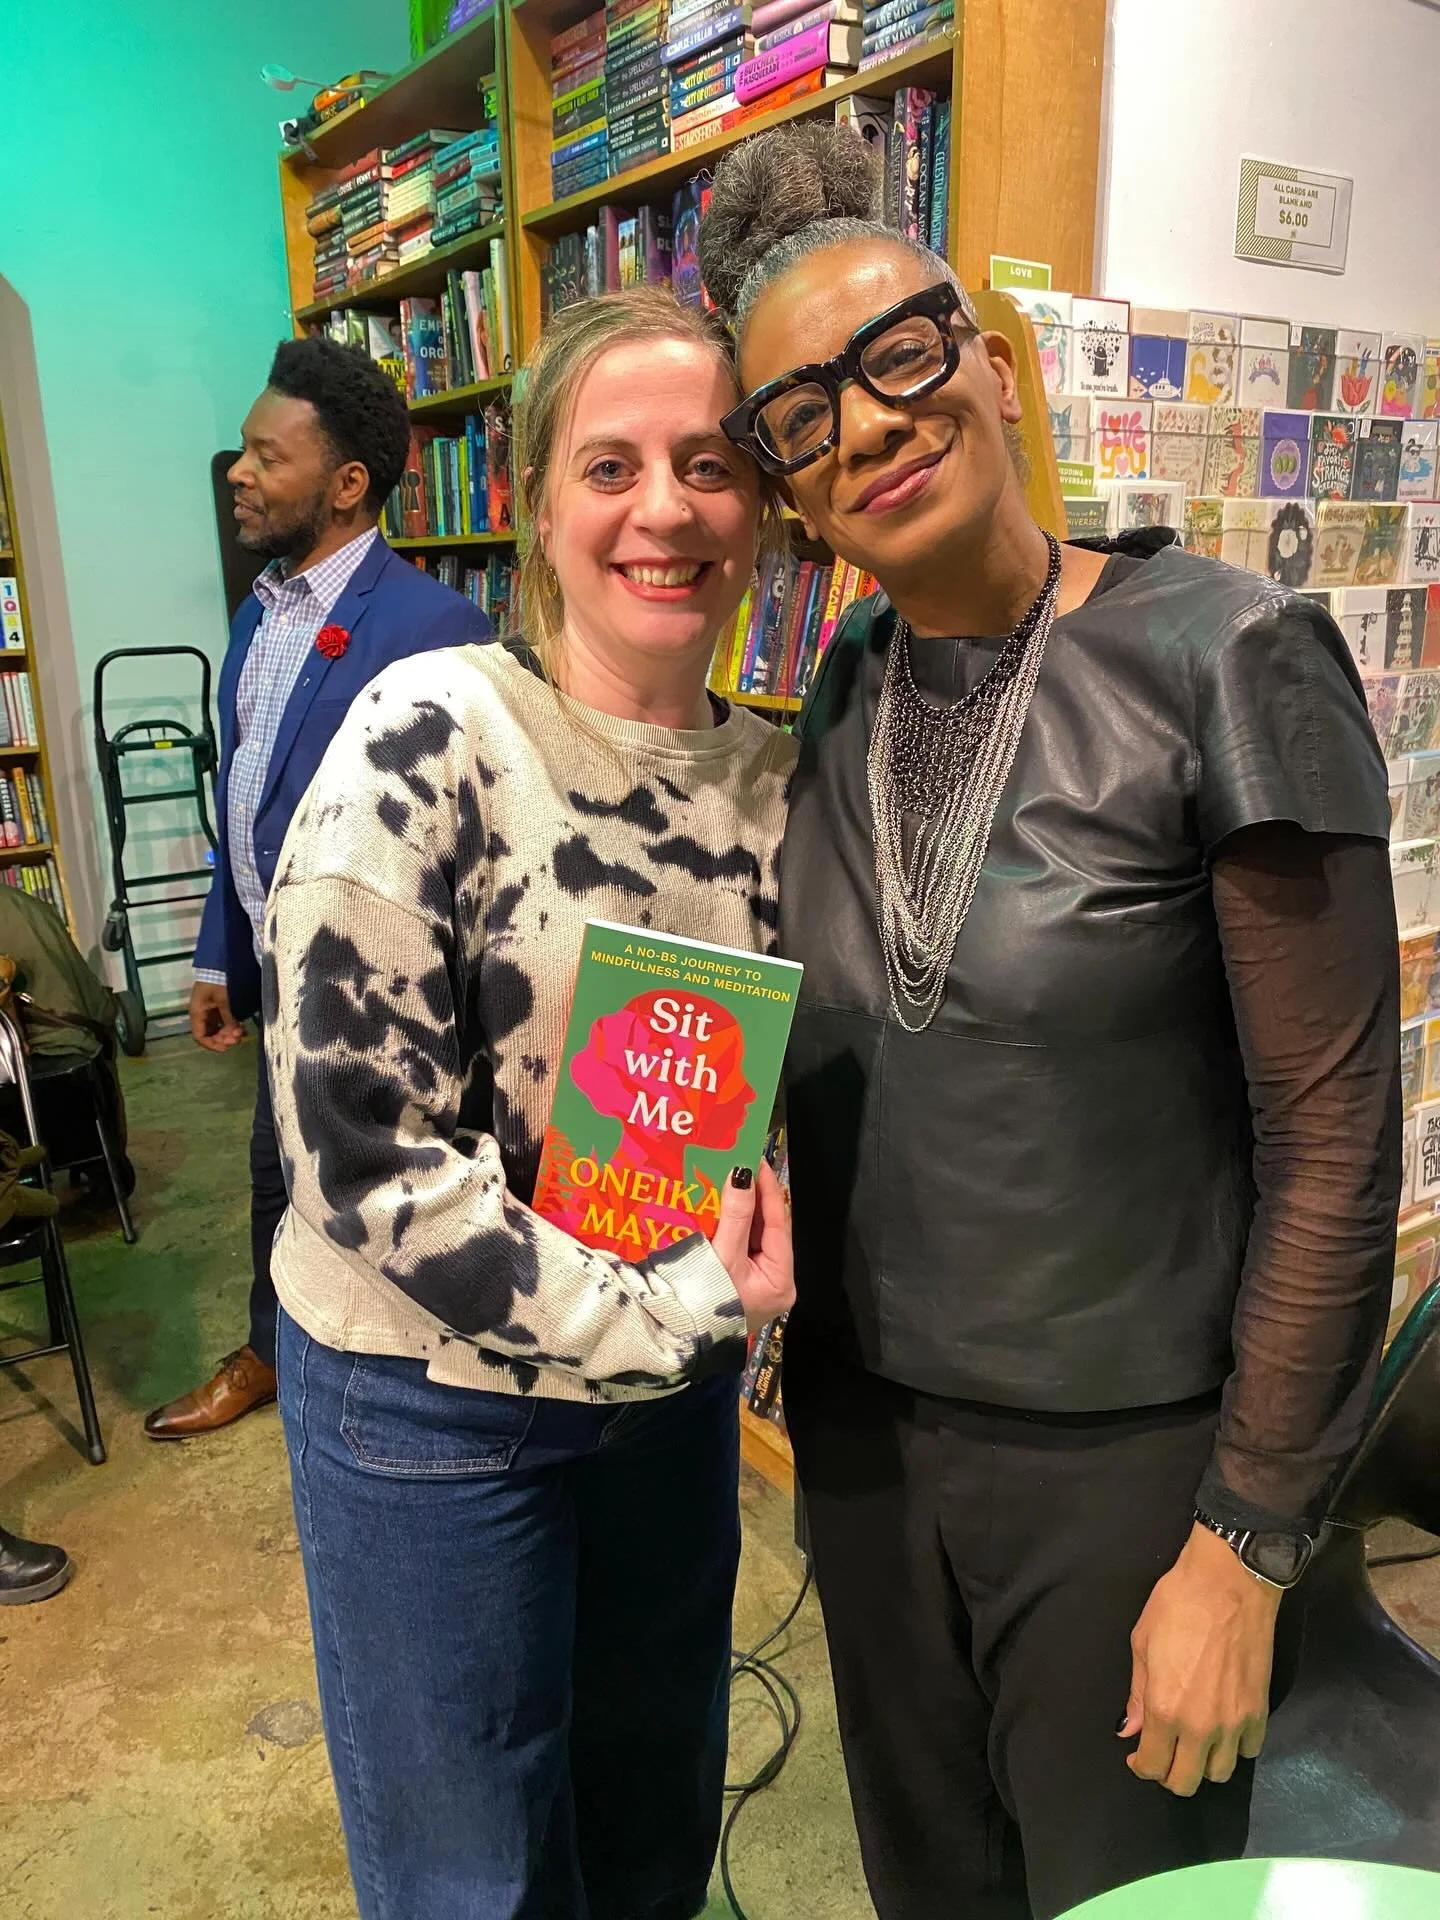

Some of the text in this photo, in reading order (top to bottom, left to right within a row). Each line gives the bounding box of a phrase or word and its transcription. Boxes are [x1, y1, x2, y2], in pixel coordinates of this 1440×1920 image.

[894, 0, 918, 20] MANY
[892, 24, 916, 44] MANY
[744, 62, 780, 86] MASQUERADE
[625, 94, 641, 107] CARVED
[680, 120, 722, 150] STARSEEKERS
[919, 163, 928, 208] OCEAN
[1274, 183, 1318, 199] ALL CARDS ARE
[931, 151, 946, 250] CELESTIAL MONSTERS
[1279, 196, 1312, 209] BLANK AND
[918, 214, 928, 245] APAR
[1279, 210, 1308, 228] $6.00
[1010, 266, 1032, 279] LOVE
[1312, 466, 1350, 486] STRANGE
[1067, 518, 1098, 526] NIVERSE
[591, 950, 791, 1002] MINDFULNESS AND MEDITATION
[624, 944, 762, 982] A NO-BS JOURNEY TO
[650, 996, 713, 1042] Sit
[624, 1048, 718, 1094] with
[627, 1090, 694, 1136] Me
[570, 1157, 721, 1220] ONEIKA
[756, 1368, 767, 1390] WING
[759, 1366, 774, 1400] FOURTH
